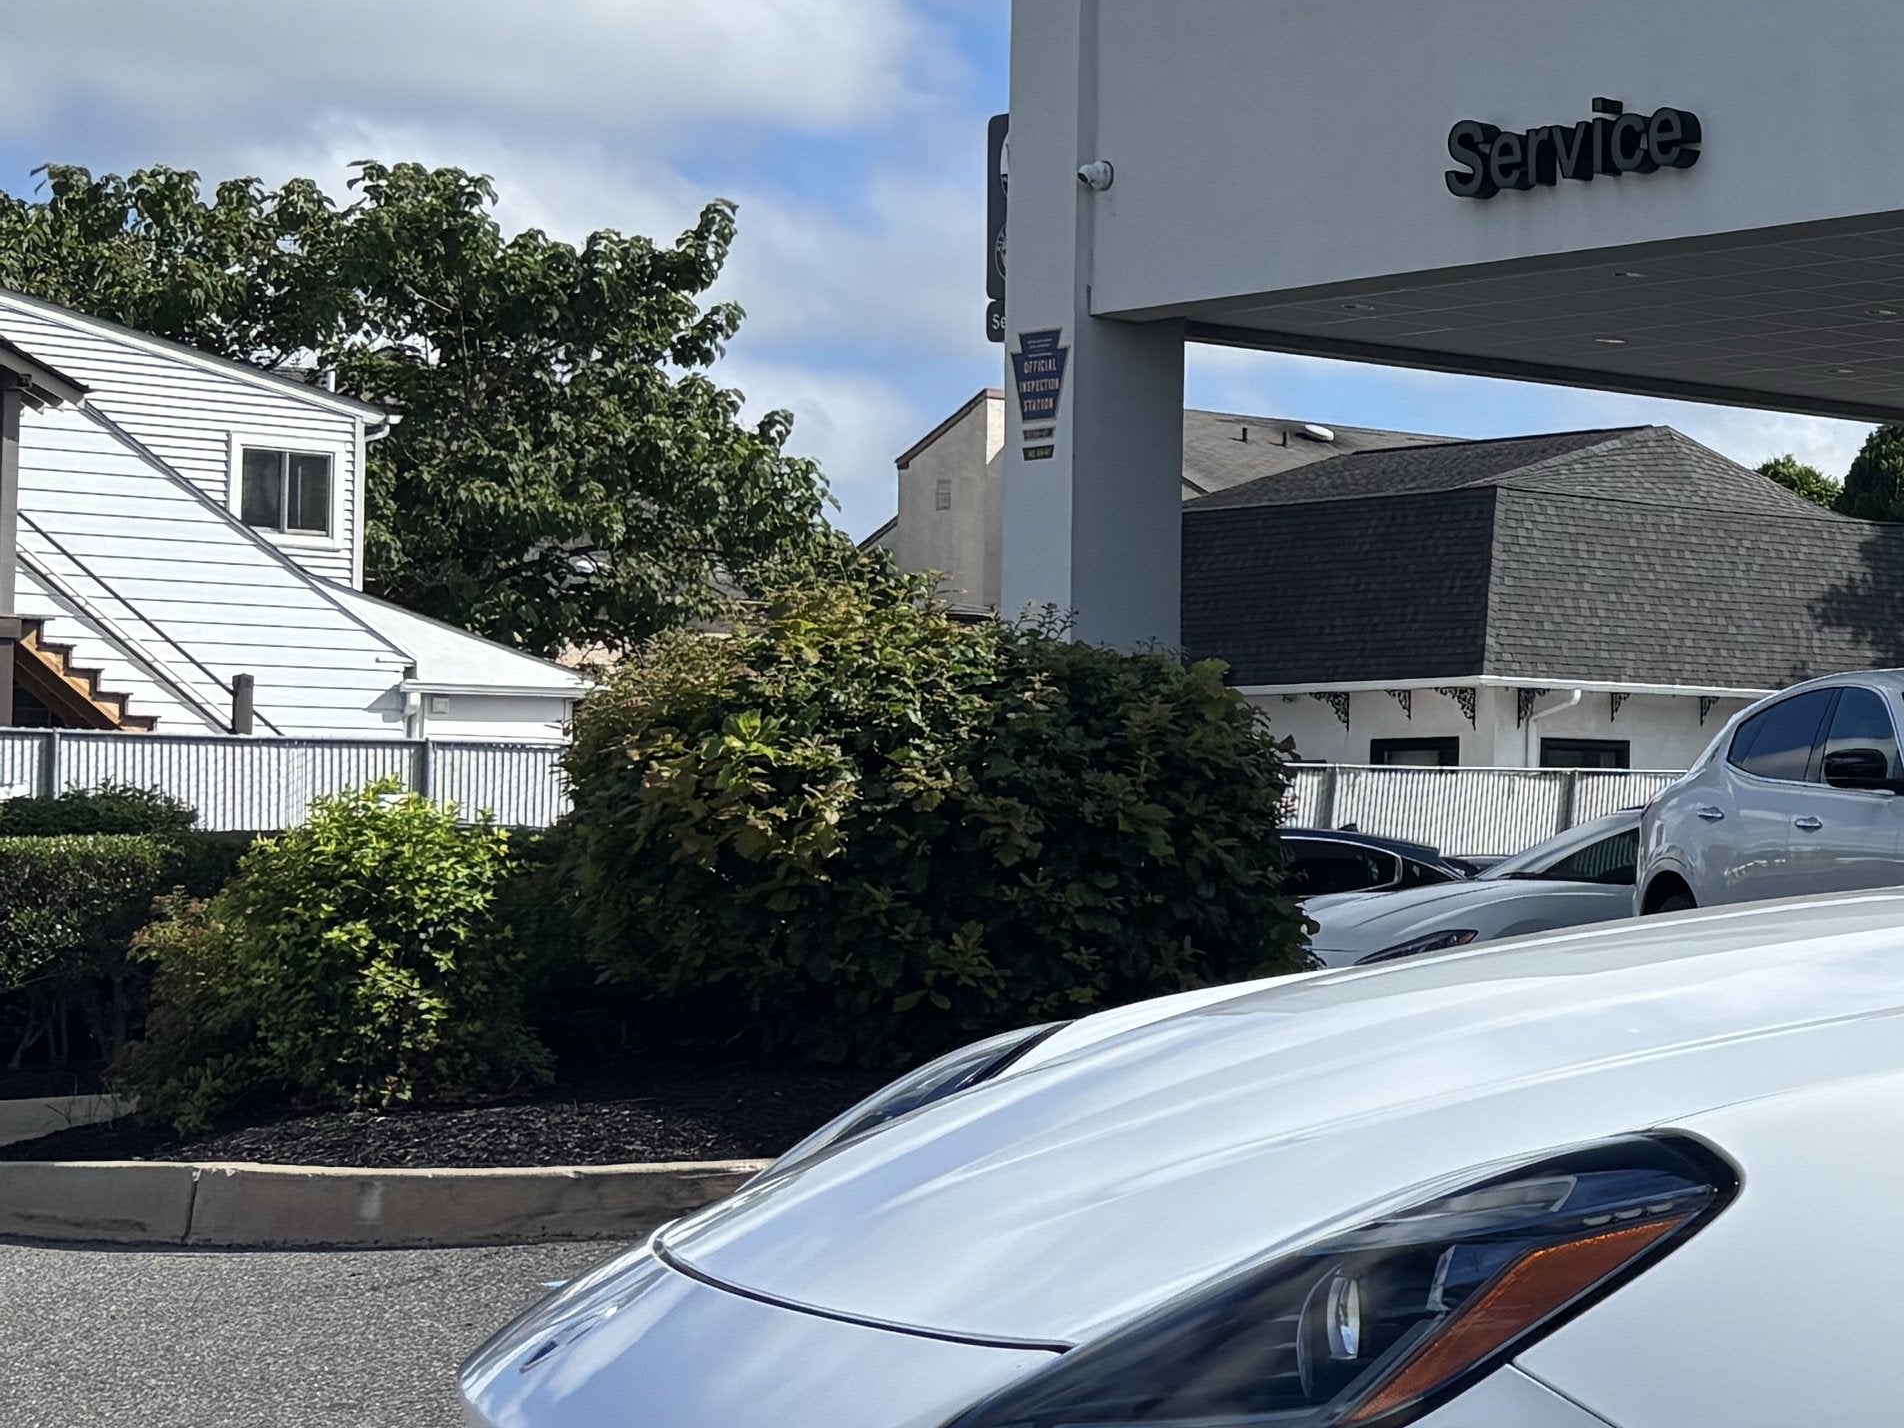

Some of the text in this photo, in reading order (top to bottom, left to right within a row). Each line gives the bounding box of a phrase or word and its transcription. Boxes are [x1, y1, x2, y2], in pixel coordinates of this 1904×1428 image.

[1445, 96, 1702, 199] Service
[1023, 357, 1057, 374] OFFICIAL
[1020, 377, 1060, 393] INSPECTION
[1023, 398, 1054, 412] STATION
